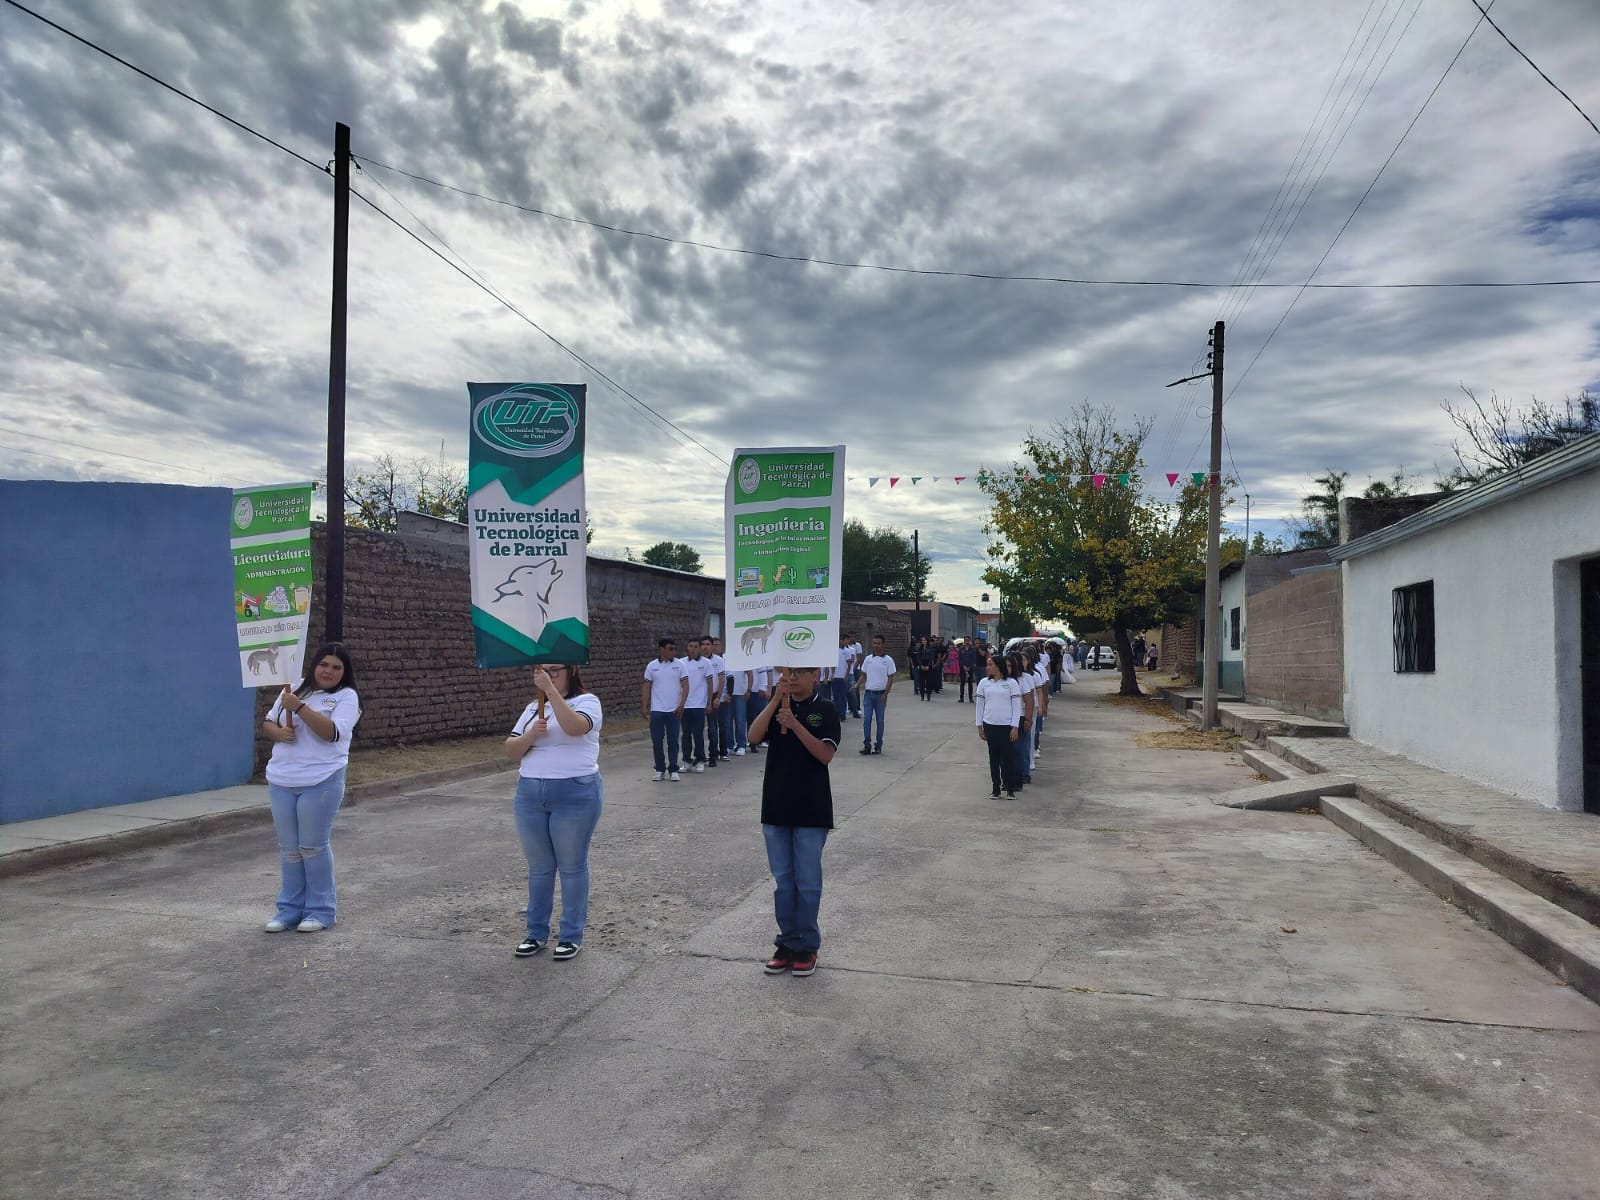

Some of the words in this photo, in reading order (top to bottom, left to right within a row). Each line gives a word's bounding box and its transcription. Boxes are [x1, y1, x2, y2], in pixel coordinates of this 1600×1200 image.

[493, 401, 568, 425] UTP
[768, 463, 824, 472] Universidad
[762, 472, 816, 482] Tecnológica
[819, 471, 831, 479] de
[781, 481, 810, 489] Parral
[259, 497, 304, 508] Universidad
[272, 515, 295, 524] Parral
[474, 507, 580, 523] Universidad
[738, 517, 825, 536] Ingeniería
[476, 524, 579, 544] Tecnológica
[489, 542, 511, 556] de
[514, 542, 568, 556] Parral
[233, 549, 310, 566] Licenciatura
[787, 594, 826, 605] BALLEZA
[786, 632, 812, 641] UTP
